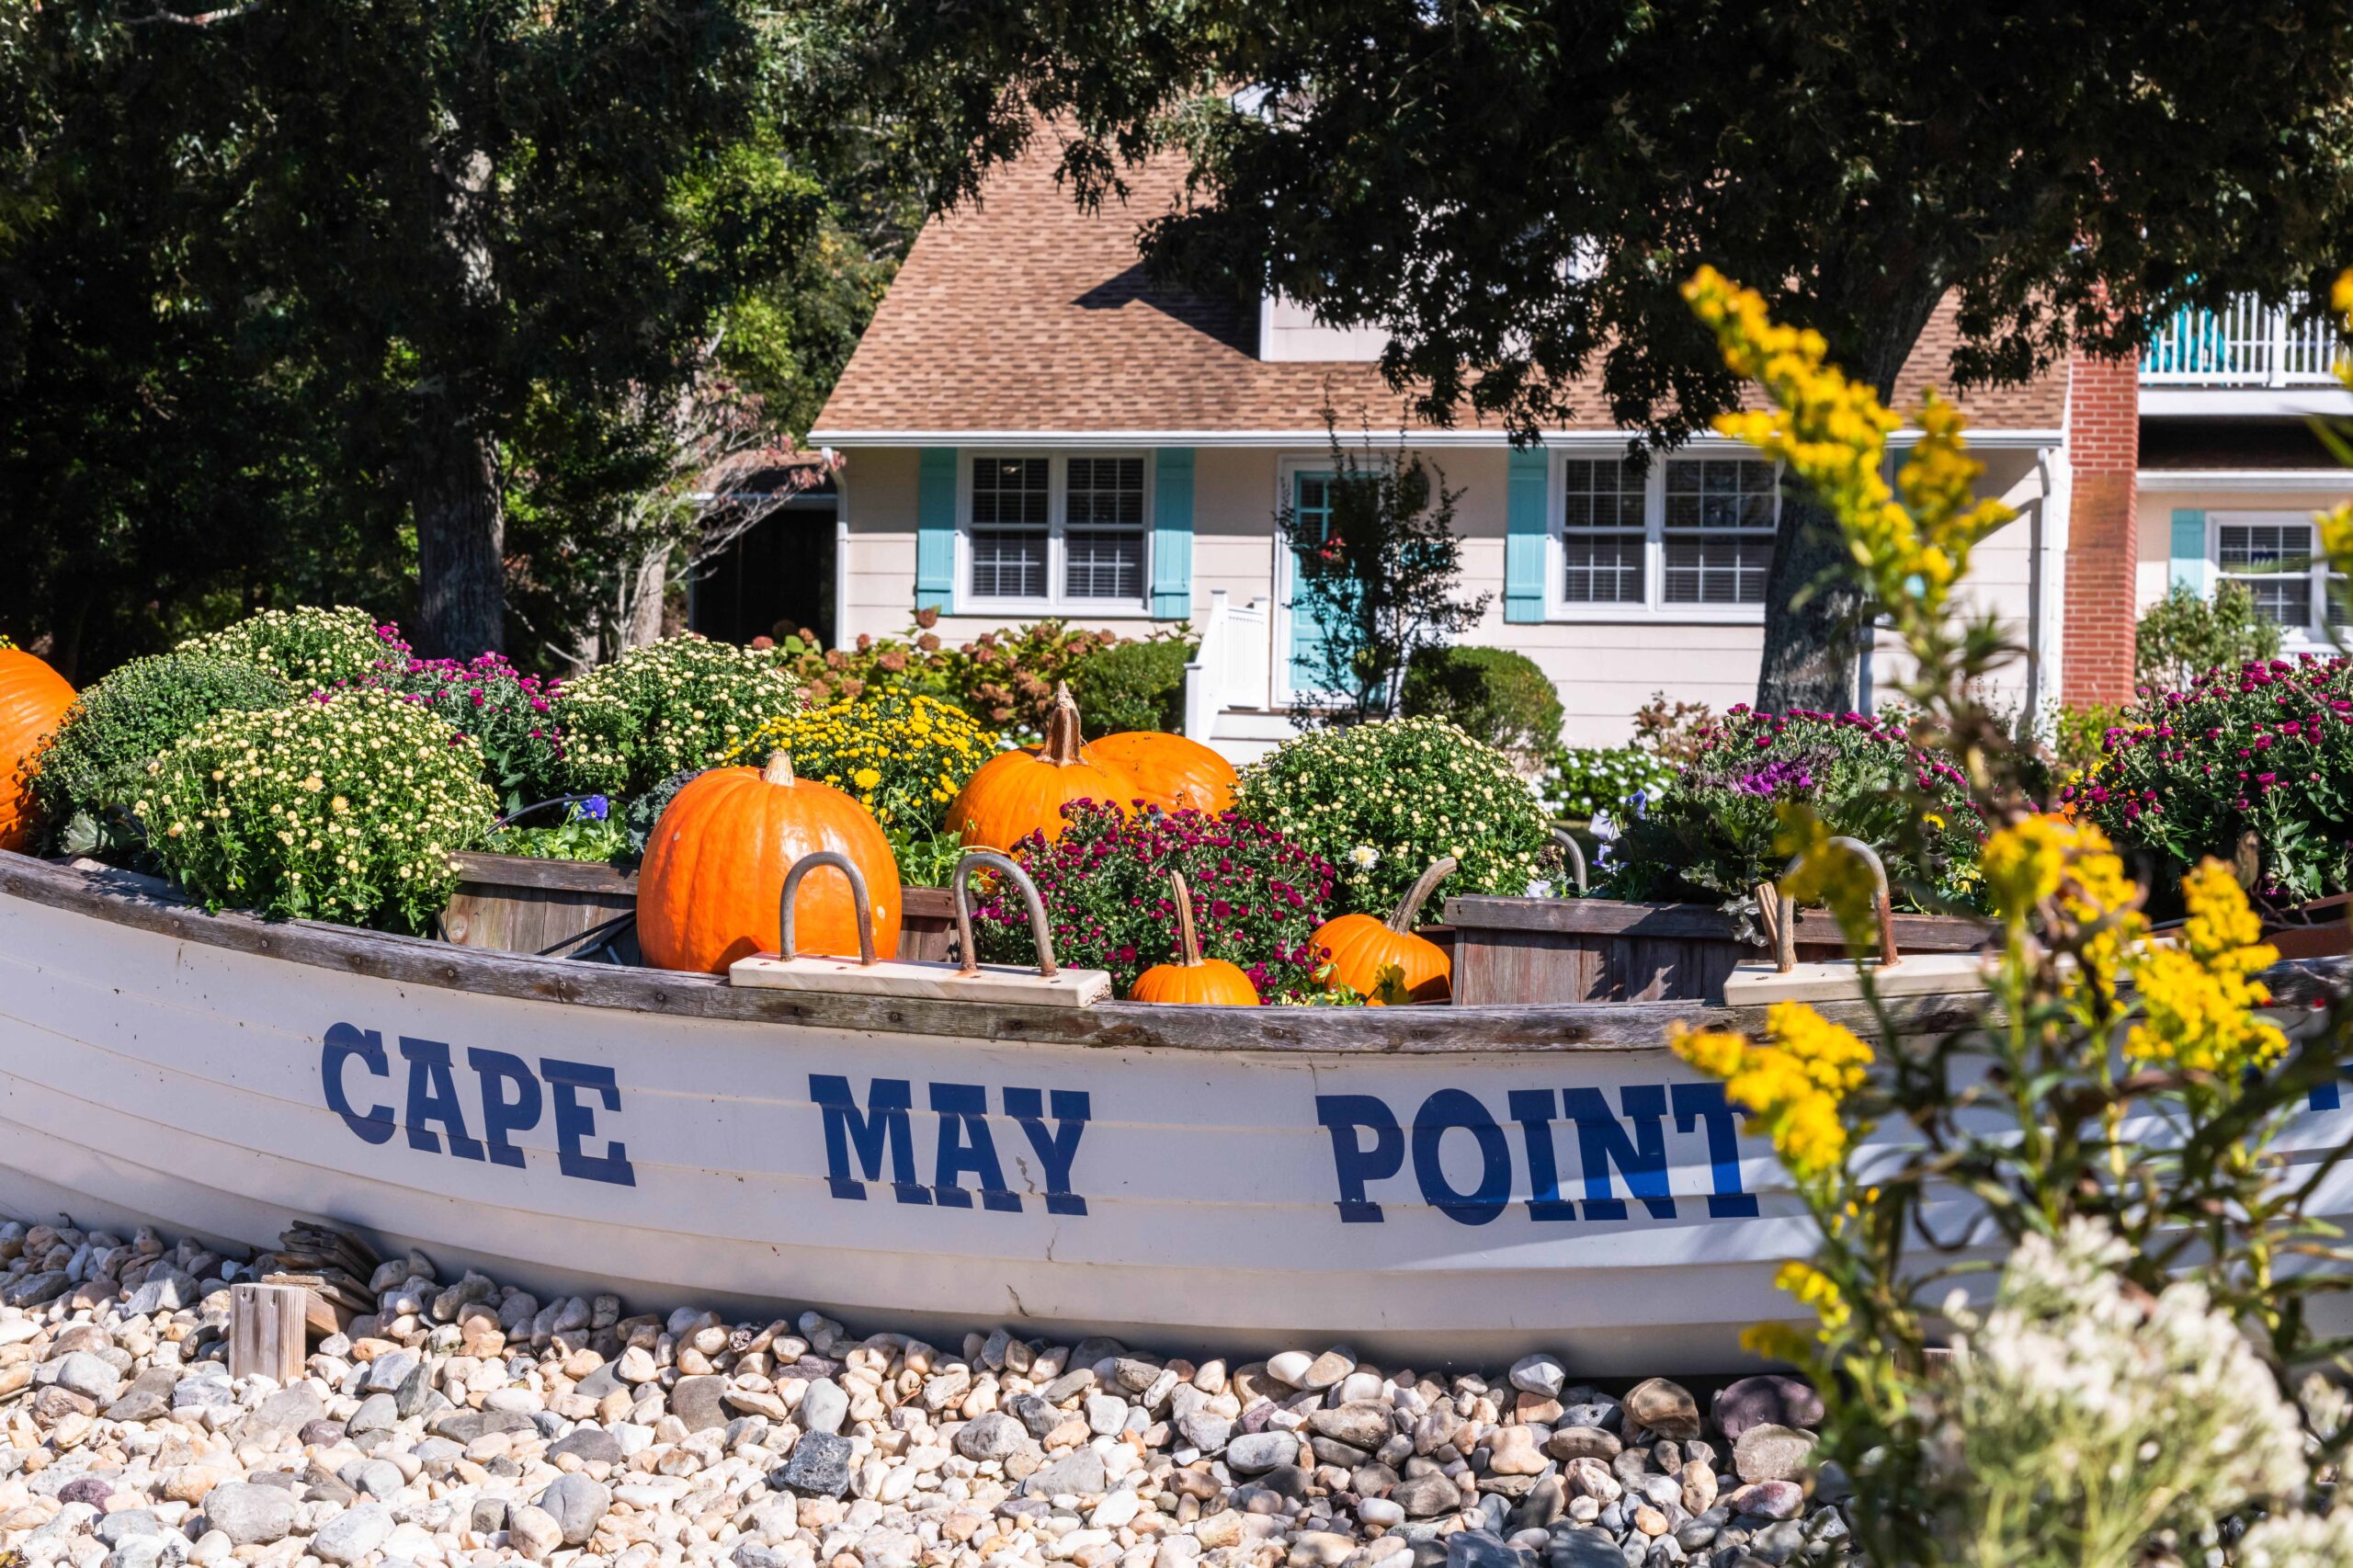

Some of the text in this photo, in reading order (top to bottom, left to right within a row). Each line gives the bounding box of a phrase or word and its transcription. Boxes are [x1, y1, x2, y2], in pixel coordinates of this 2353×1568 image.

[322, 1022, 1760, 1226] CAPE MAY POINT
